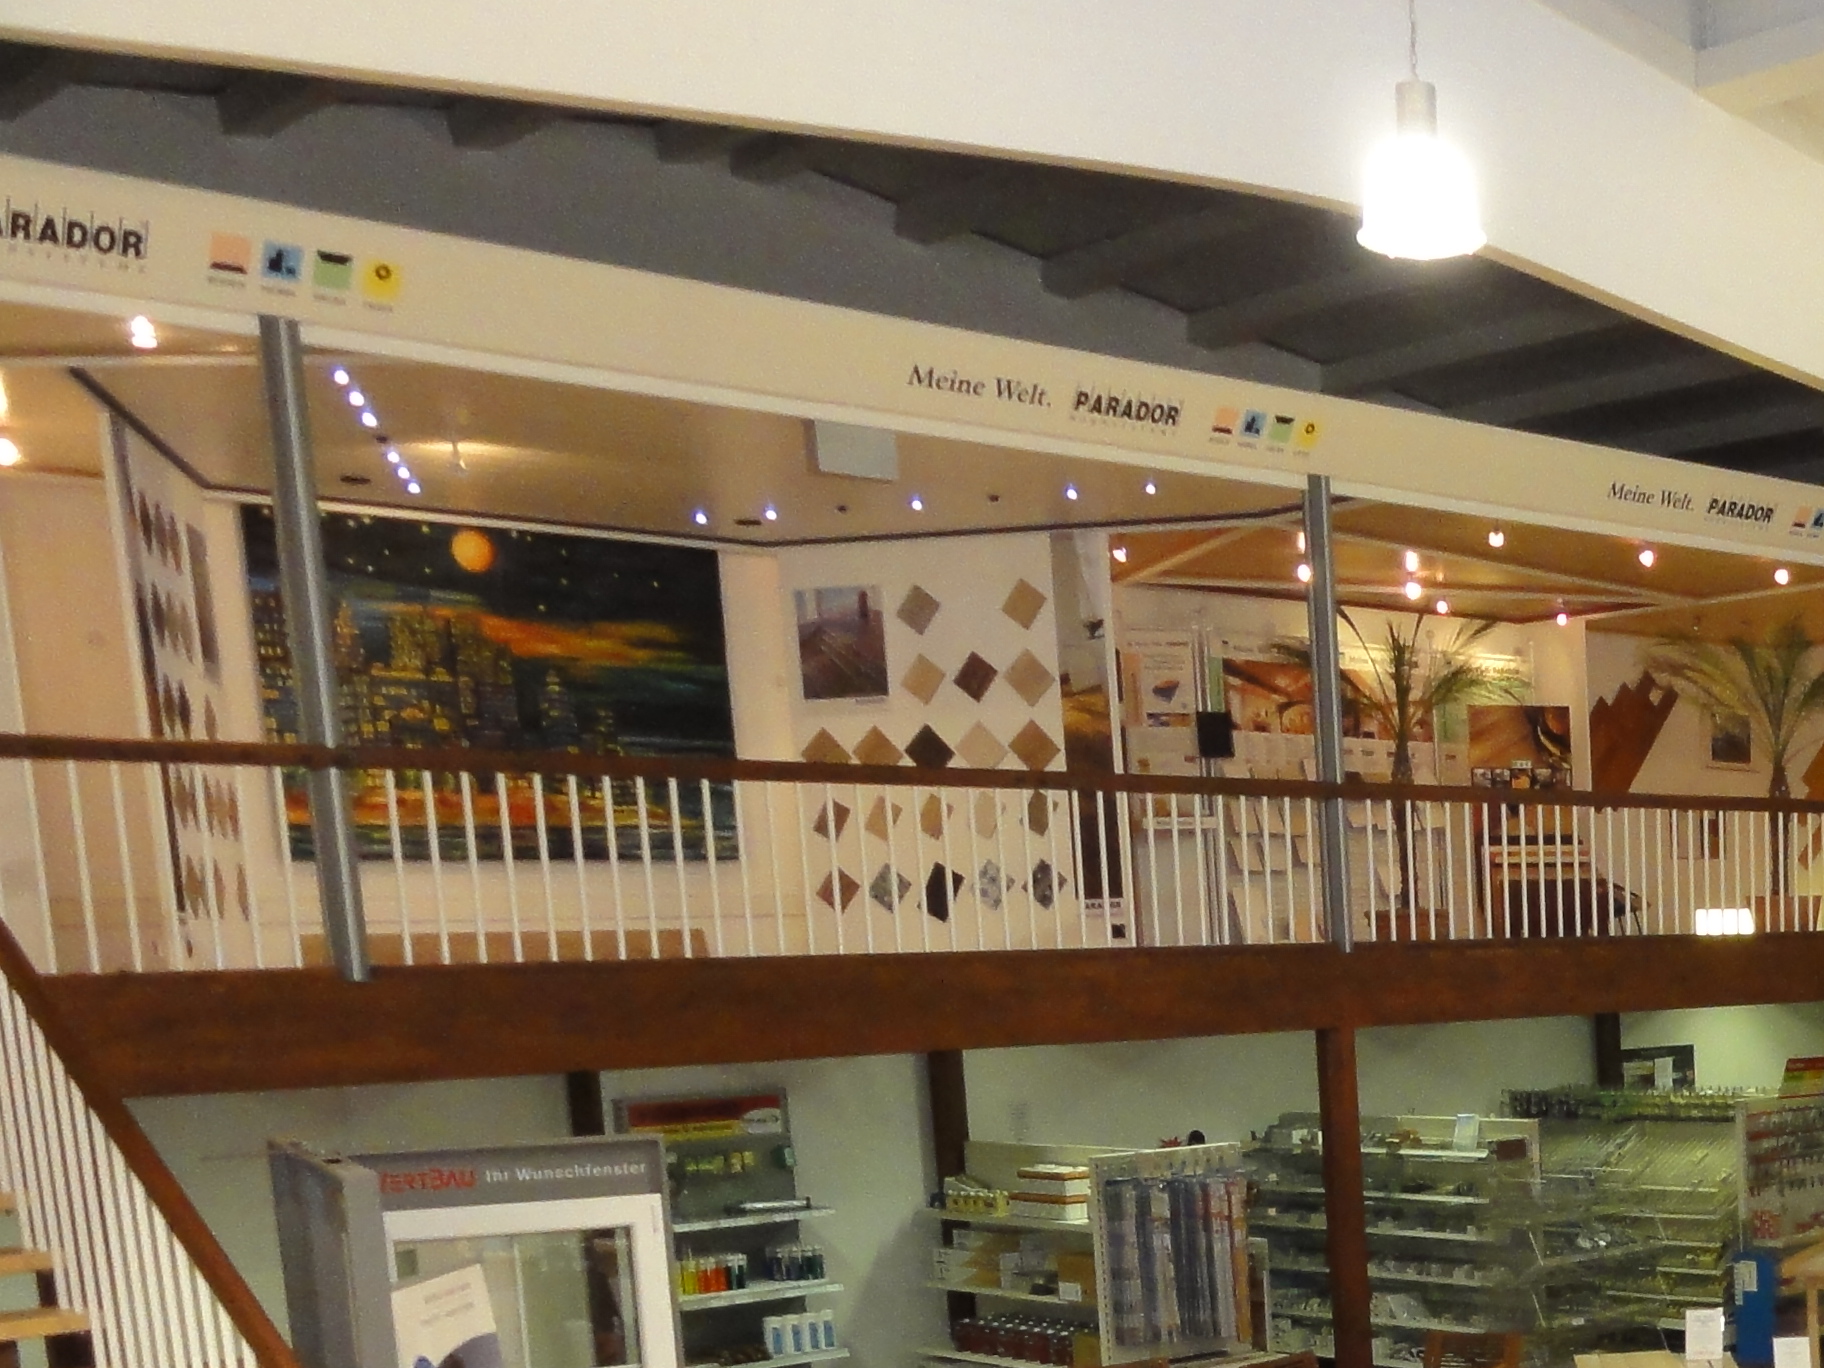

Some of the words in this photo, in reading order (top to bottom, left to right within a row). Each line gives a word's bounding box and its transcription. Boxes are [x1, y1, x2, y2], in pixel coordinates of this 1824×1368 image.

[0, 209, 146, 259] RADOR
[906, 364, 986, 397] Meine
[995, 377, 1052, 408] Welt.
[1074, 389, 1181, 427] PARADOR
[1607, 480, 1655, 505] Meine
[1706, 497, 1775, 524] PARADOR
[516, 1161, 646, 1182] Wunschfenster
